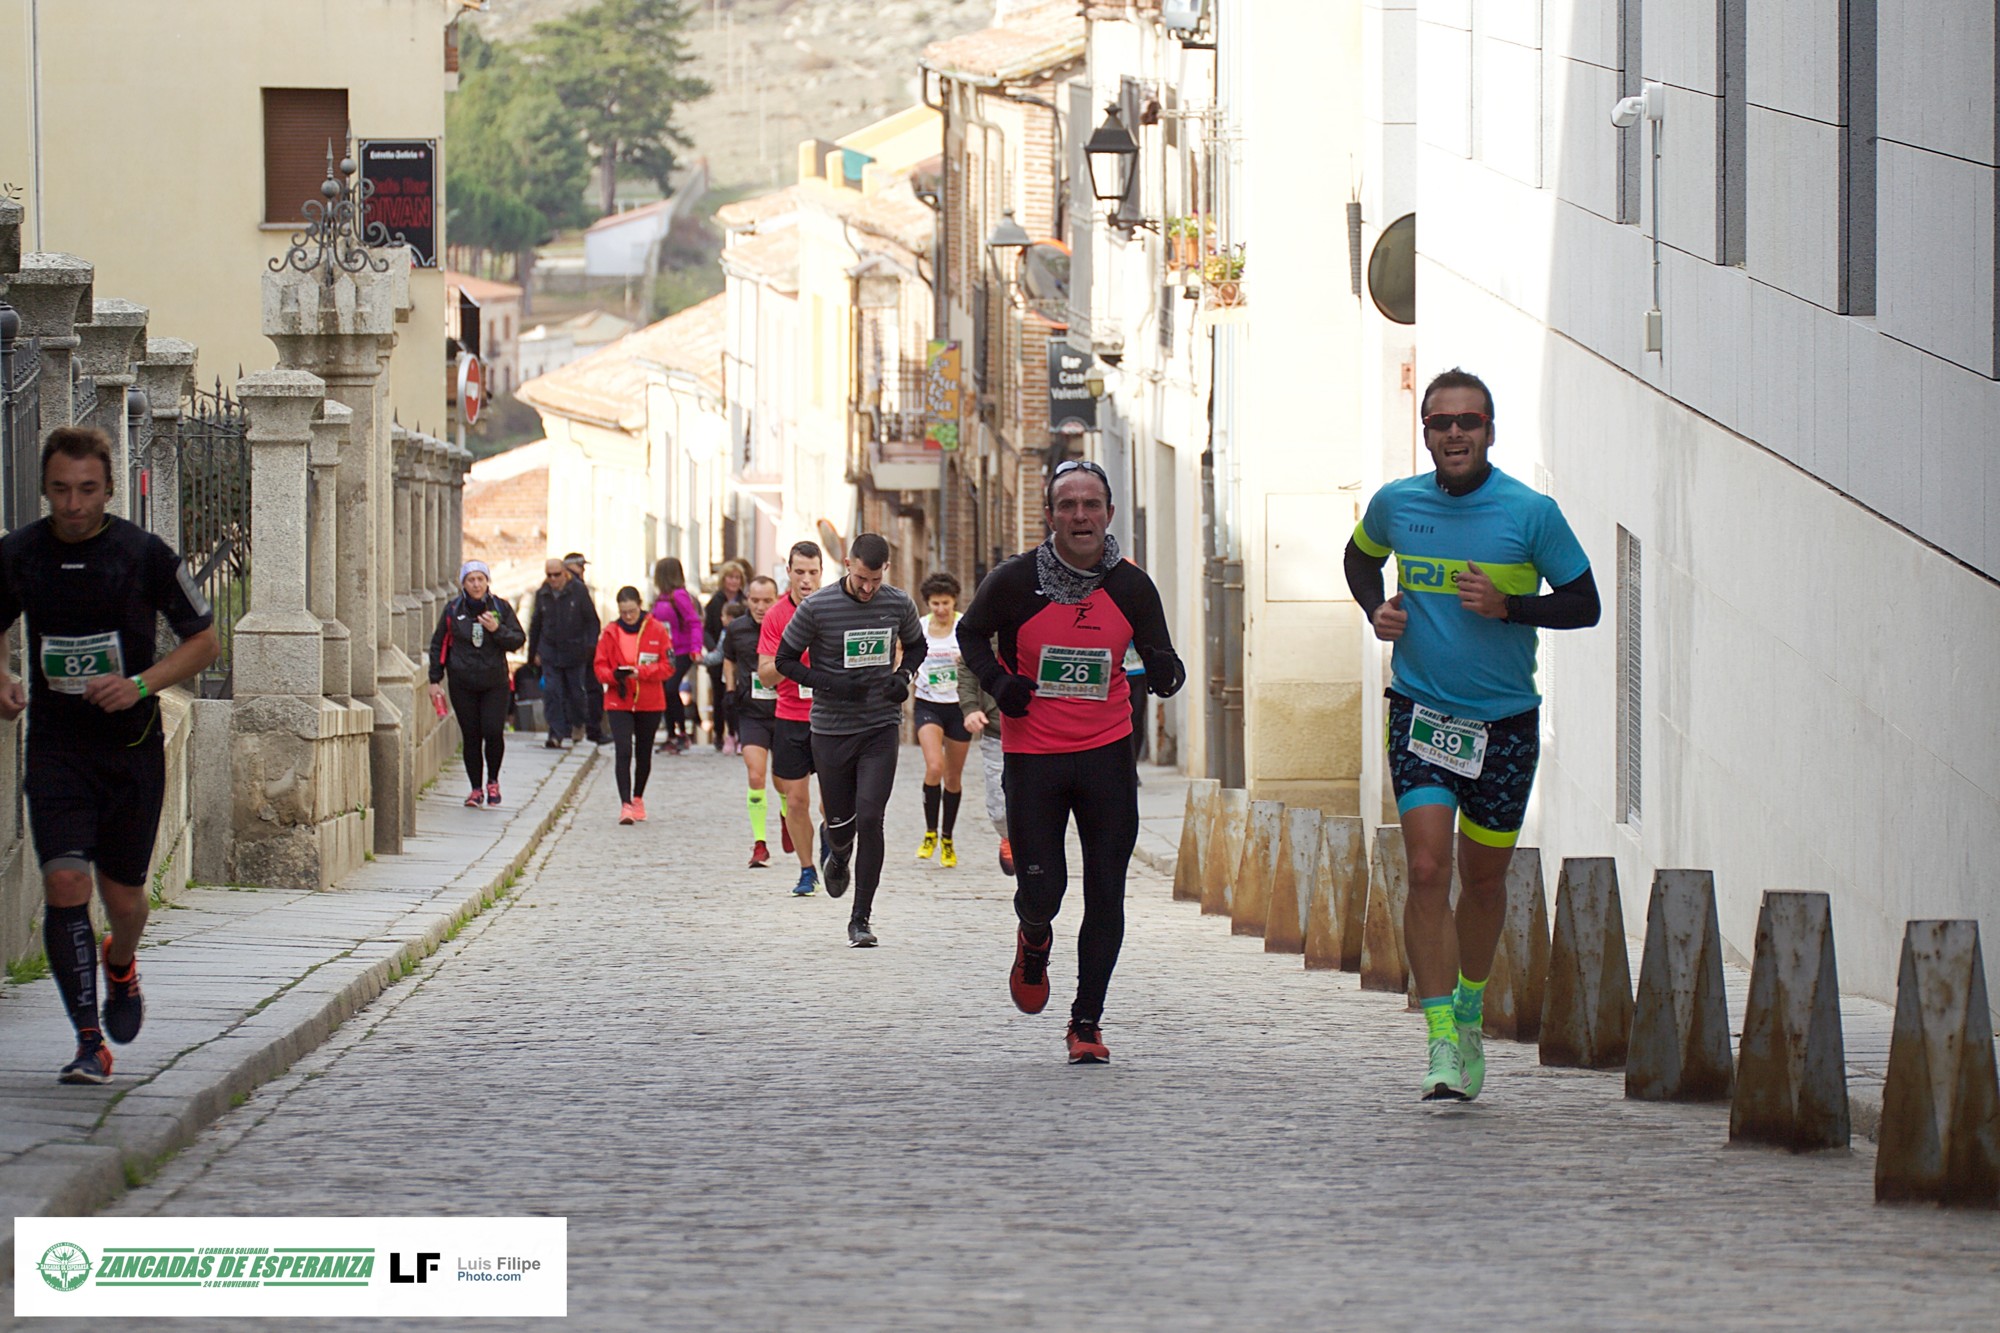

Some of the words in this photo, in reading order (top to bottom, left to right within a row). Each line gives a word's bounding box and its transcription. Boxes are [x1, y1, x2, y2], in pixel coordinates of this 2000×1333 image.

[1061, 355, 1082, 369] Bar
[1059, 371, 1085, 385] Casa
[858, 641, 878, 655] 97
[65, 655, 98, 675] 82
[1059, 663, 1090, 683] 26
[1431, 730, 1462, 755] 89
[67, 921, 92, 1007] kalenji
